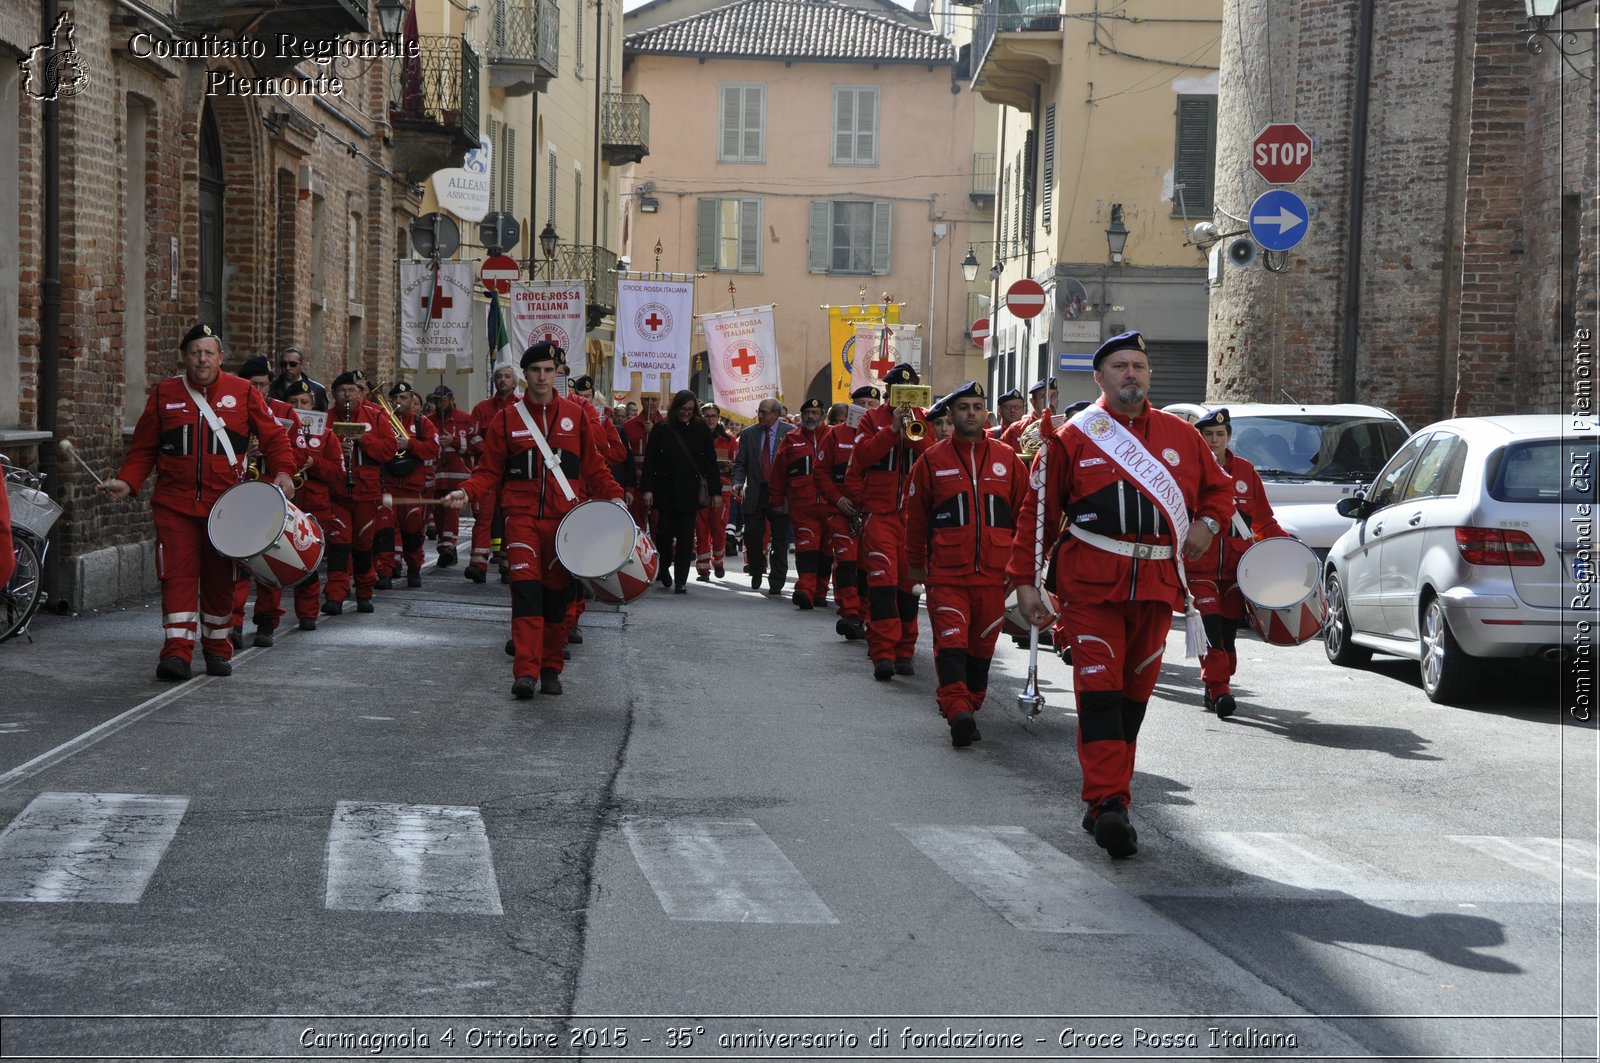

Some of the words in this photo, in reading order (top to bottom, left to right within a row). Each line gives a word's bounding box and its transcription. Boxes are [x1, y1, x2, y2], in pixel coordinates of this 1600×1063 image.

[1256, 142, 1308, 166] STOP
[444, 274, 470, 296] ITALIANA
[516, 292, 546, 300] CROCE
[549, 292, 580, 300] ROSSA
[528, 302, 569, 311] ITALIANA
[715, 322, 738, 331] CROCE
[724, 328, 756, 338] ITALIANA
[629, 362, 675, 370] CARMAGNOLA
[720, 388, 750, 396] COMITATO
[751, 384, 776, 392] LOCALE
[730, 393, 768, 403] NICHELINO
[1114, 439, 1158, 479] CROCE
[1150, 469, 1181, 516] ROSSA
